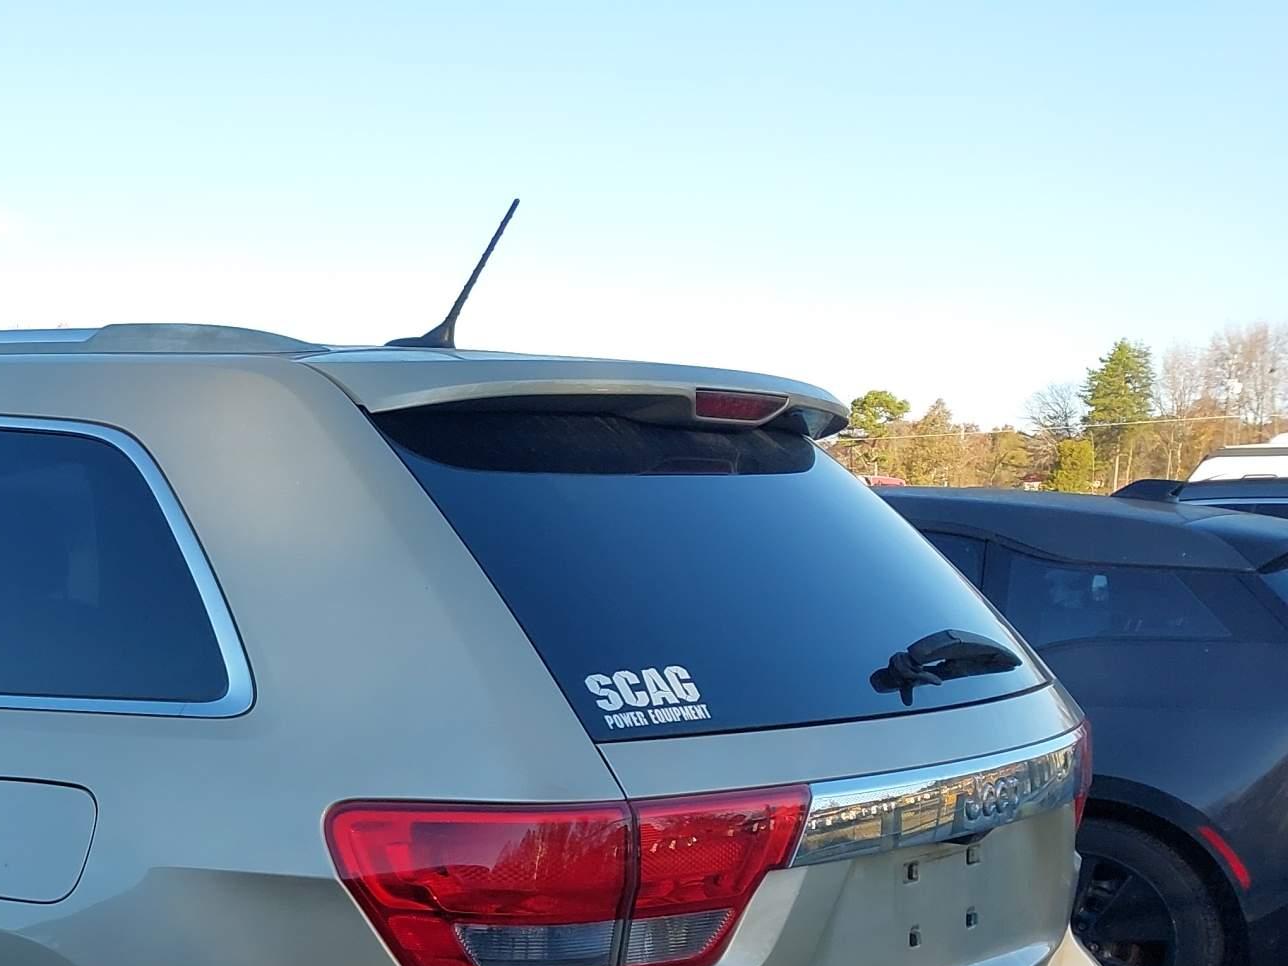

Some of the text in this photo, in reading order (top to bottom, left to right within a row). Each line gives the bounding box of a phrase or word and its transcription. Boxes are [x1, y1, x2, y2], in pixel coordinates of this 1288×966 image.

[584, 665, 701, 712] SCAG
[603, 704, 712, 730] POWER EQUIPMENT
